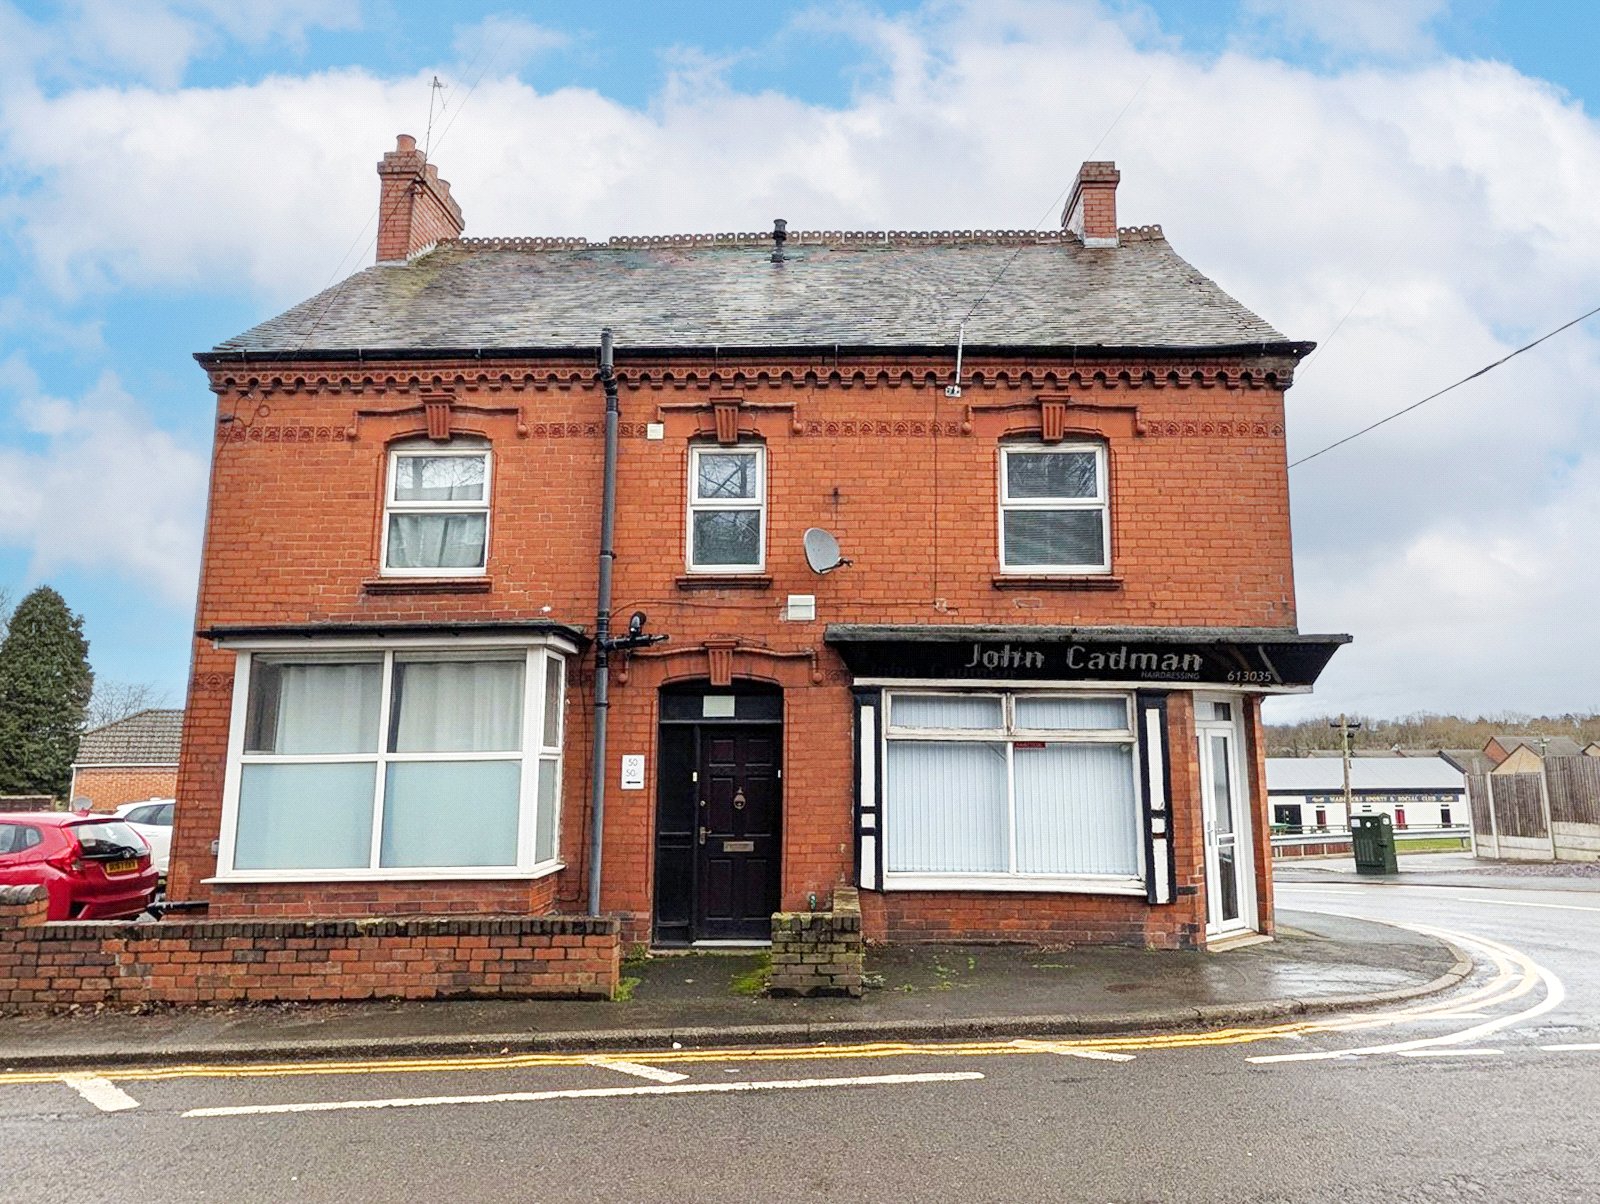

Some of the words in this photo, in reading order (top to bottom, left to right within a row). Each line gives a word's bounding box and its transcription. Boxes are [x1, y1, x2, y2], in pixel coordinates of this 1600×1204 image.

[965, 643, 1045, 669] John
[1066, 645, 1203, 671] Cadman
[1141, 671, 1201, 680] HAIRDRESSING
[1227, 671, 1272, 682] 613035
[628, 758, 638, 767] 50
